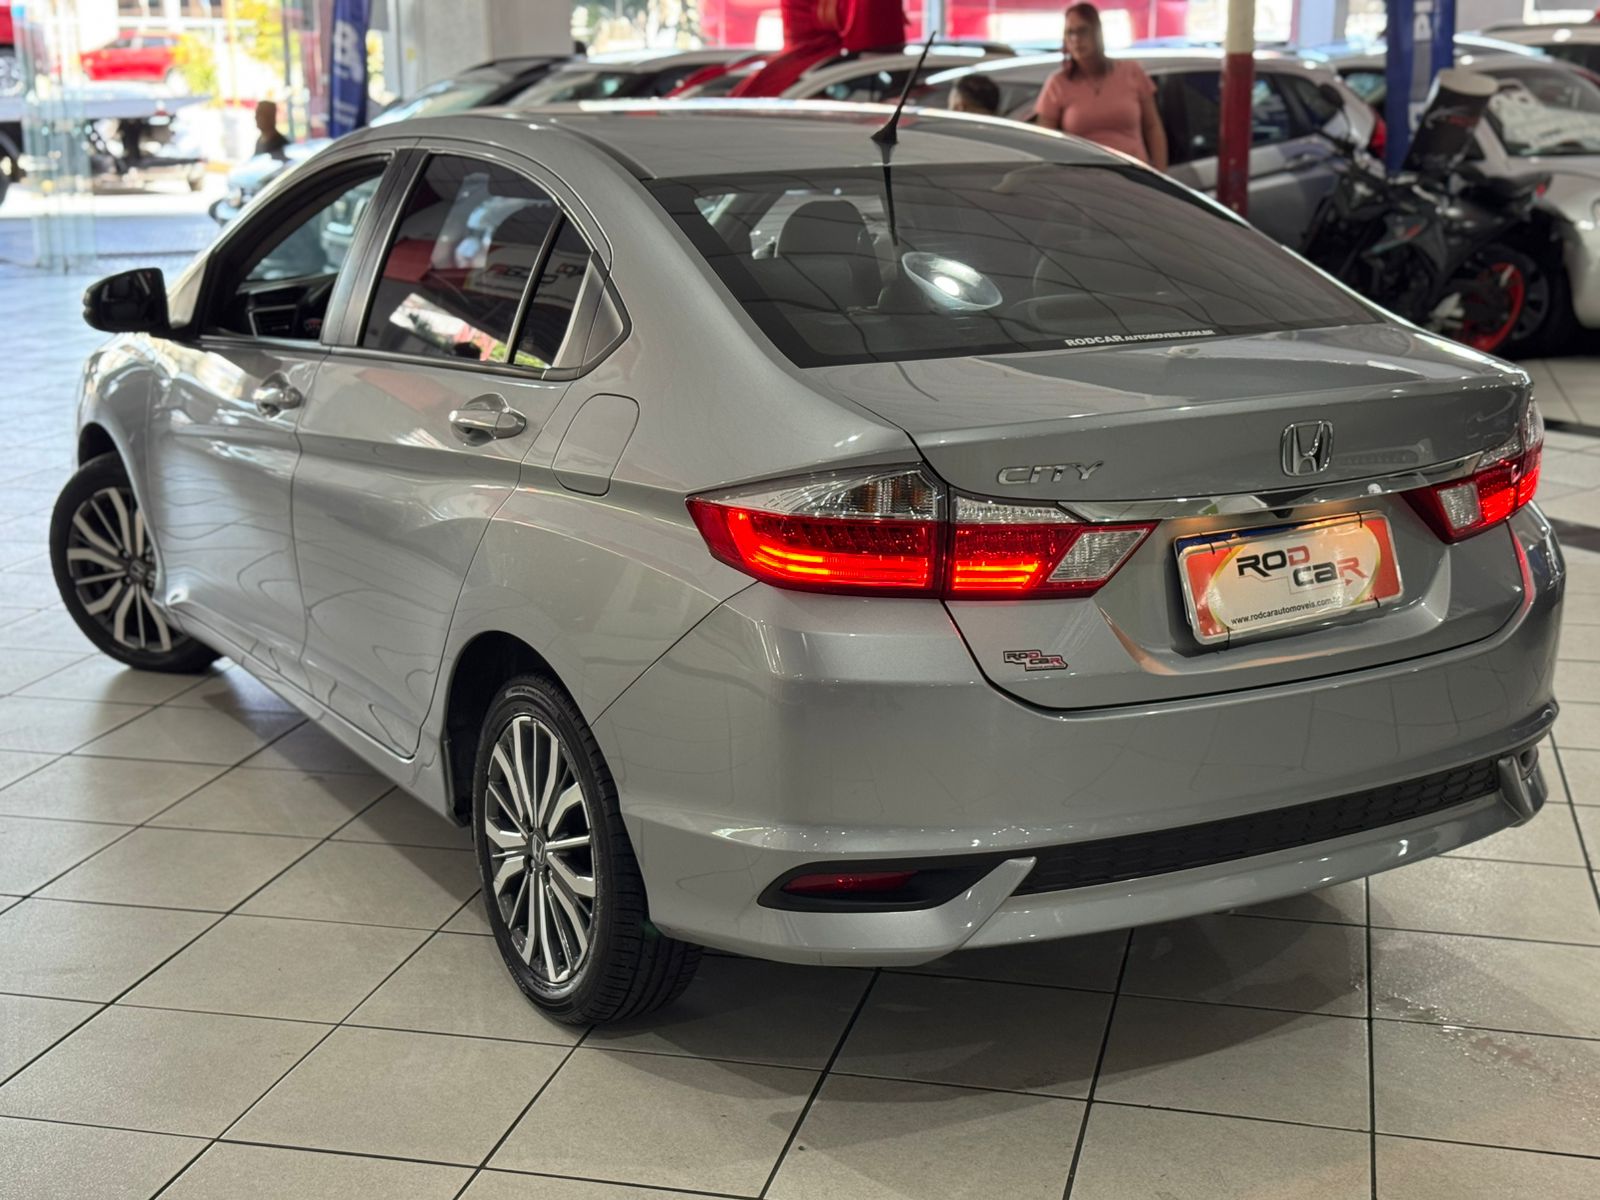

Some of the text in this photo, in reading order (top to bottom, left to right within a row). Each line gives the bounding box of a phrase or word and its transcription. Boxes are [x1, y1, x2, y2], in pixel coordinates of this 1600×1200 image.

[997, 460, 1104, 486] CITY
[1236, 545, 1311, 578] ROD
[1006, 652, 1039, 660] ROD
